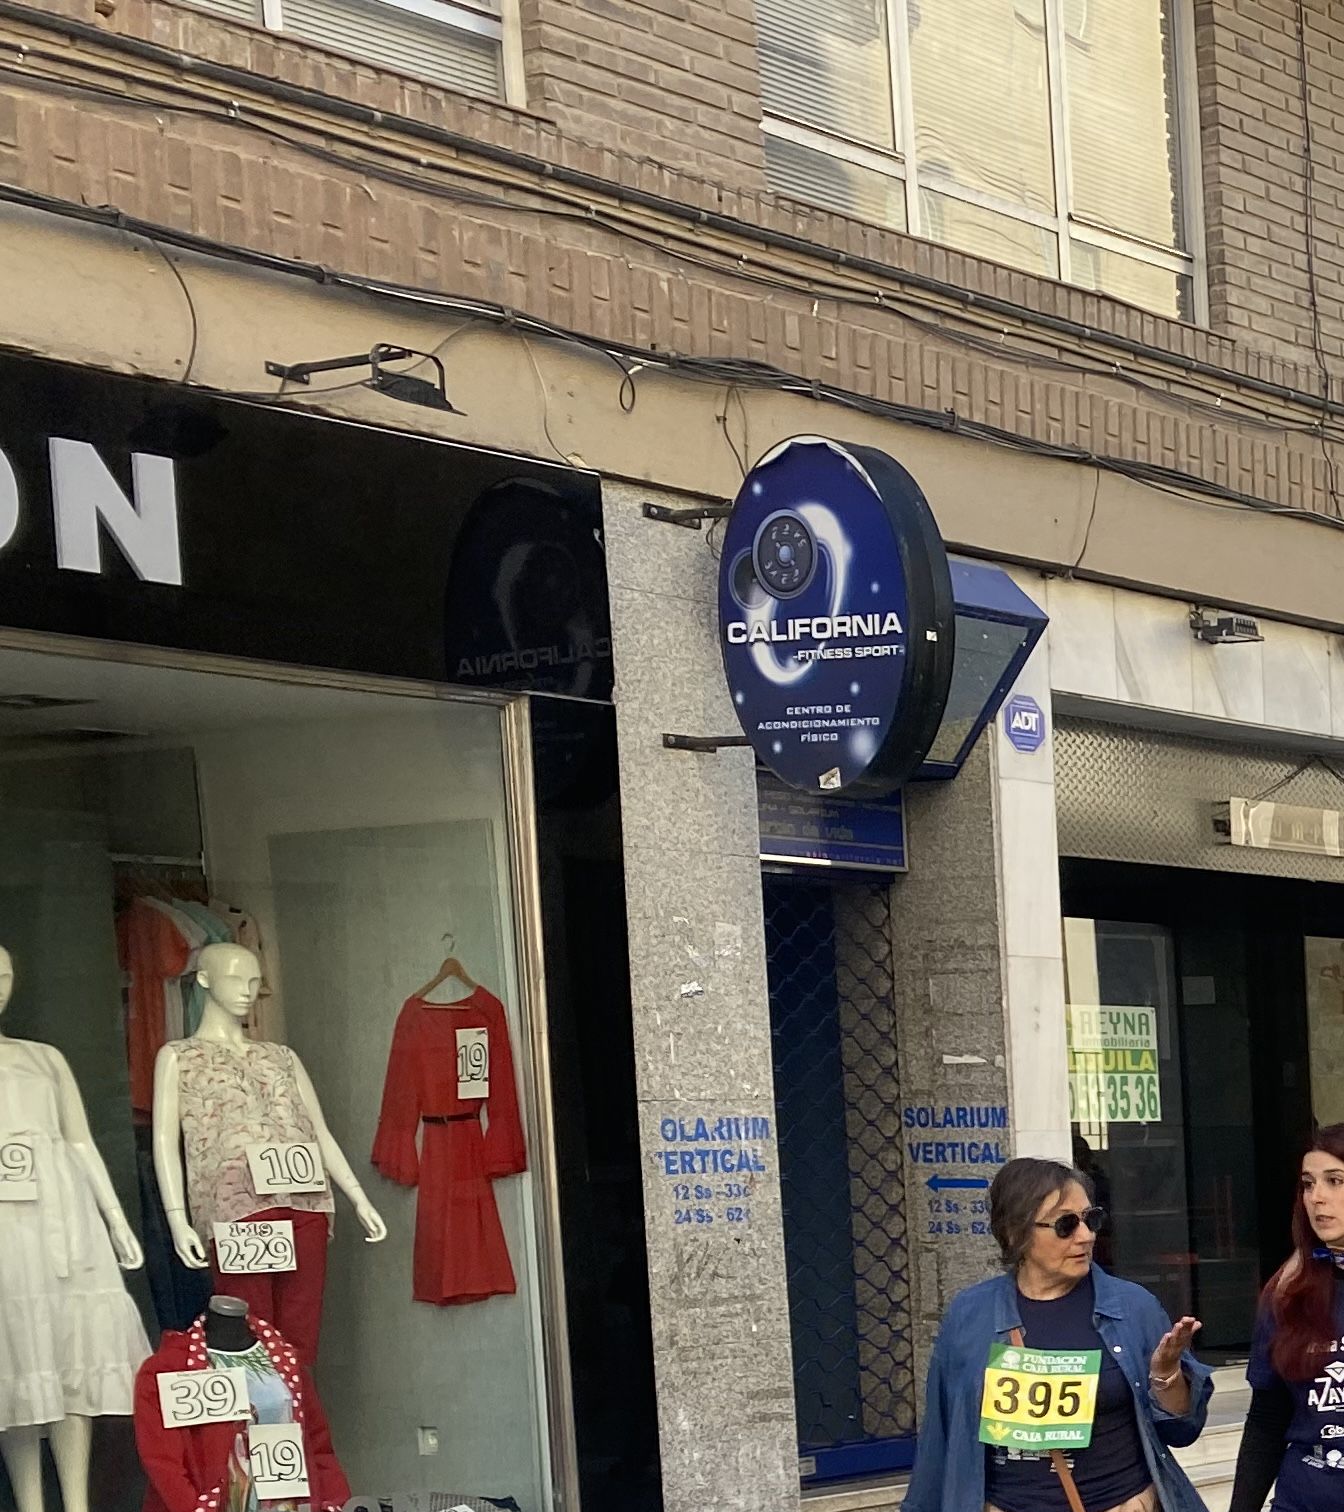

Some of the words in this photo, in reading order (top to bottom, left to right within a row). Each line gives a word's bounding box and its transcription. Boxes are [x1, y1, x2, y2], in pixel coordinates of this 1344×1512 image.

[727, 612, 903, 644] CALIFORNIA
[786, 705, 833, 715] CENTRO
[836, 704, 851, 713] DE
[1011, 711, 1039, 731] ADT
[757, 717, 880, 730] ACONDICIONAMIENTO
[457, 1042, 487, 1082] 19
[1107, 1076, 1131, 1119] 35
[1135, 1075, 1158, 1119] 36
[904, 1106, 1009, 1128] SOLARIUM
[260, 1145, 315, 1185] 10
[655, 1149, 765, 1175] ERTICAL
[908, 1142, 1006, 1163] VERTICAL
[674, 1209, 691, 1224] 24
[171, 1375, 236, 1420] 39
[994, 1377, 1082, 1418] 395
[1012, 1430, 1042, 1441] CAJA
[1044, 1431, 1084, 1441] RURAL
[251, 1440, 302, 1482] 19
